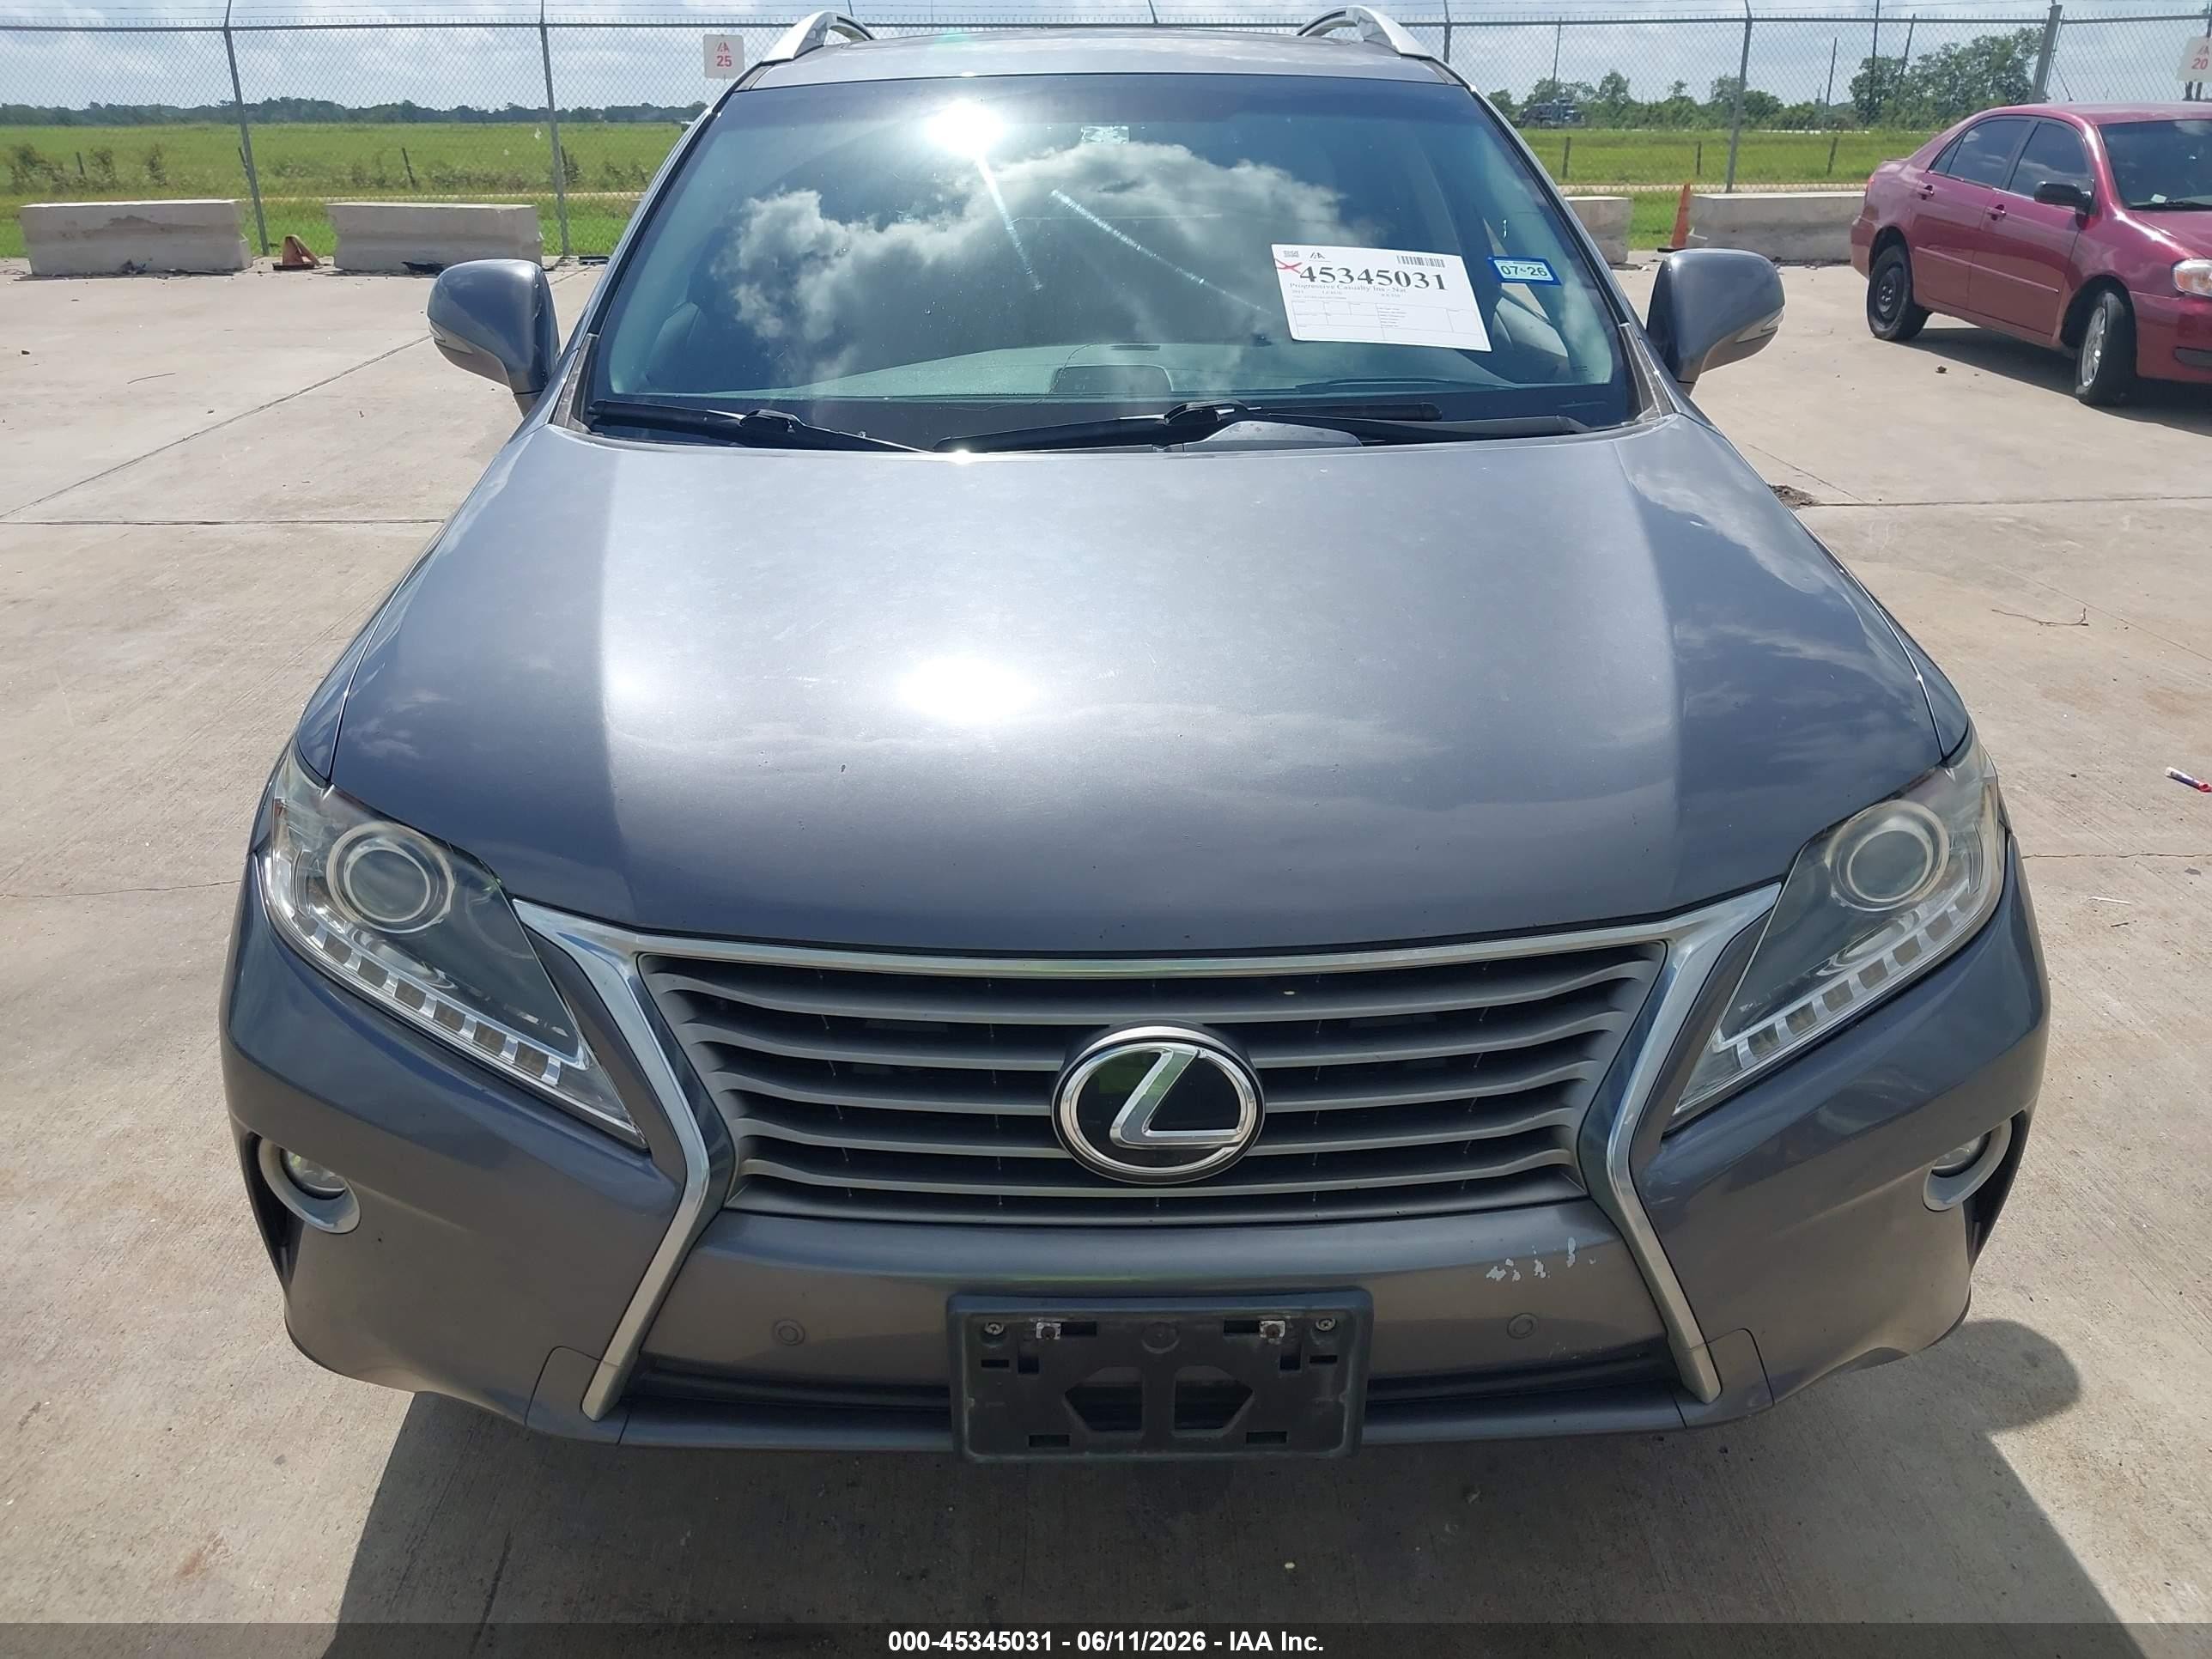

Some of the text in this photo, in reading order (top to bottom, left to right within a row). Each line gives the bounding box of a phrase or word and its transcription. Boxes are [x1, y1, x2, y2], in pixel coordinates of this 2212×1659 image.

[717, 55, 732, 66] 25
[2191, 58, 2209, 70] 20
[1299, 265, 1449, 291] 45345031
